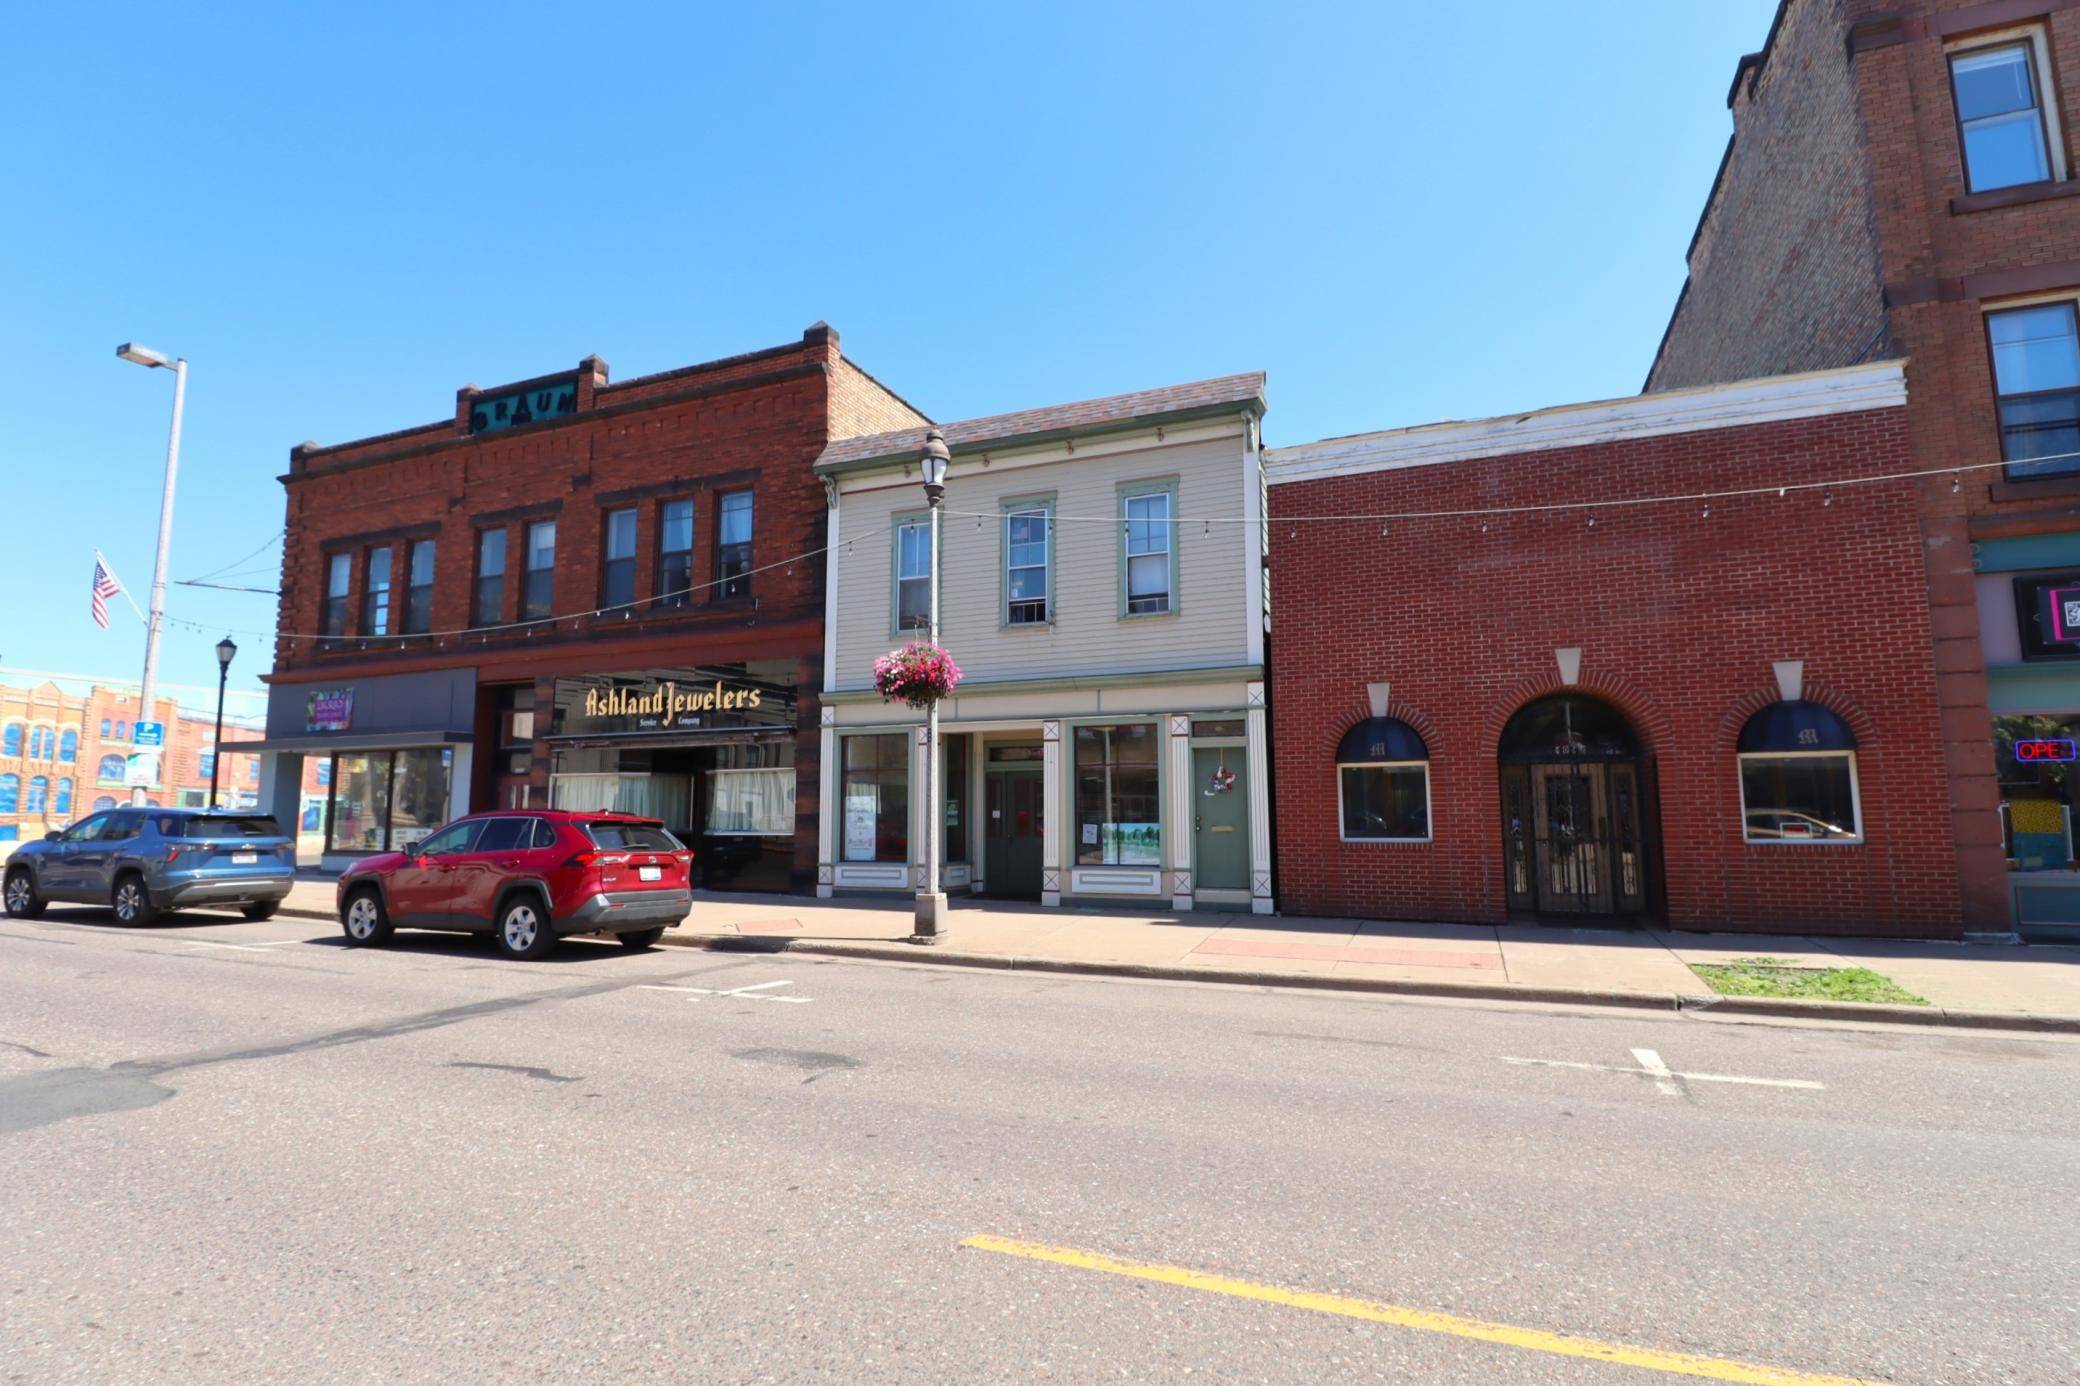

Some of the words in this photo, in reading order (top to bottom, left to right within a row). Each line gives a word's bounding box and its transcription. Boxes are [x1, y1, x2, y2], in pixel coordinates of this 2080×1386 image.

[585, 684, 663, 717] Ashland
[662, 680, 761, 727] Jewelers
[144, 723, 154, 733] P
